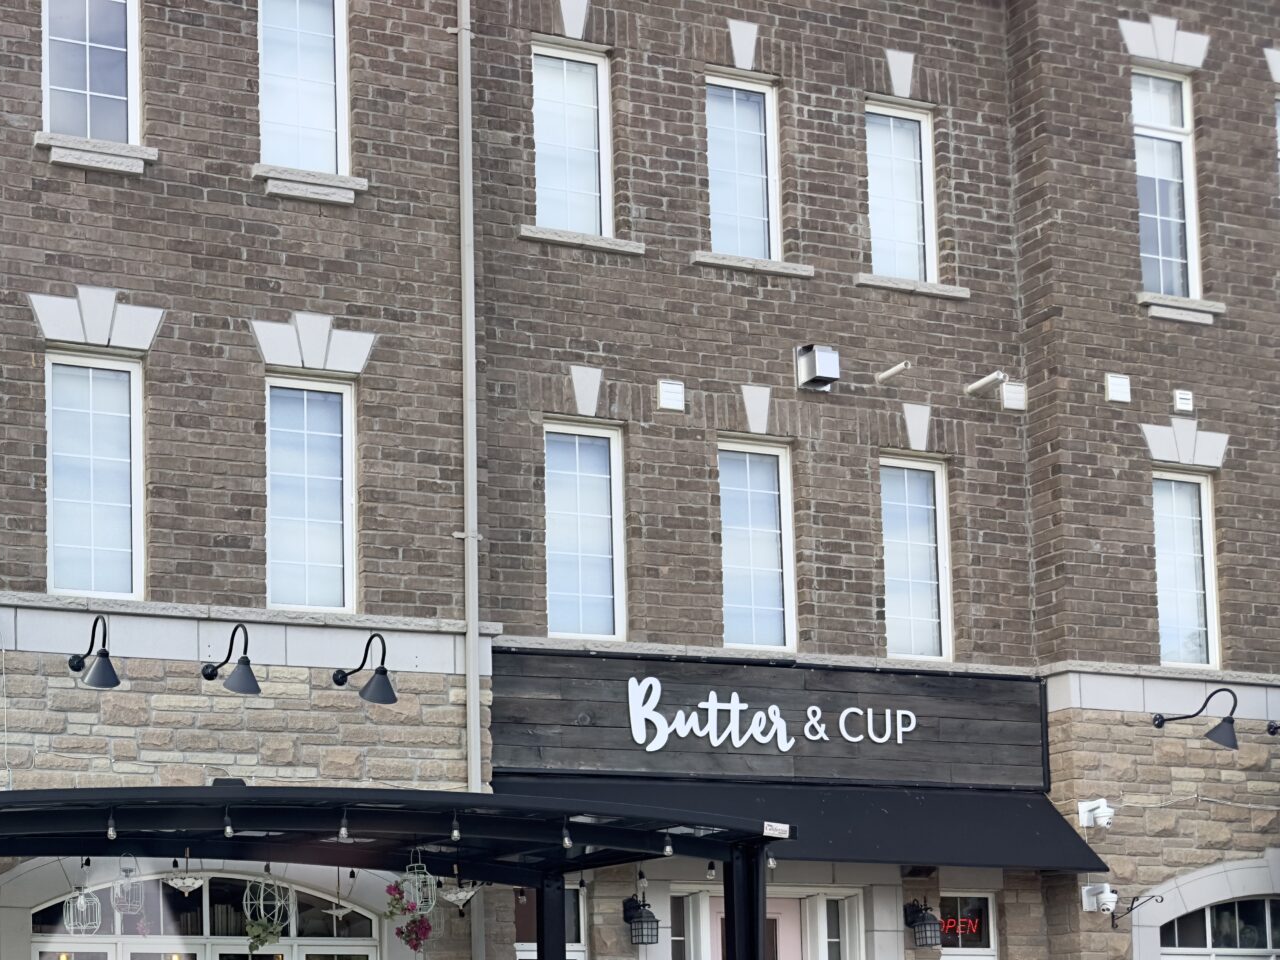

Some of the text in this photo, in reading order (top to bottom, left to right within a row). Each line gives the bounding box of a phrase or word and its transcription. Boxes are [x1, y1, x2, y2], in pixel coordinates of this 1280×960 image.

[627, 676, 917, 752] Butter & CUP
